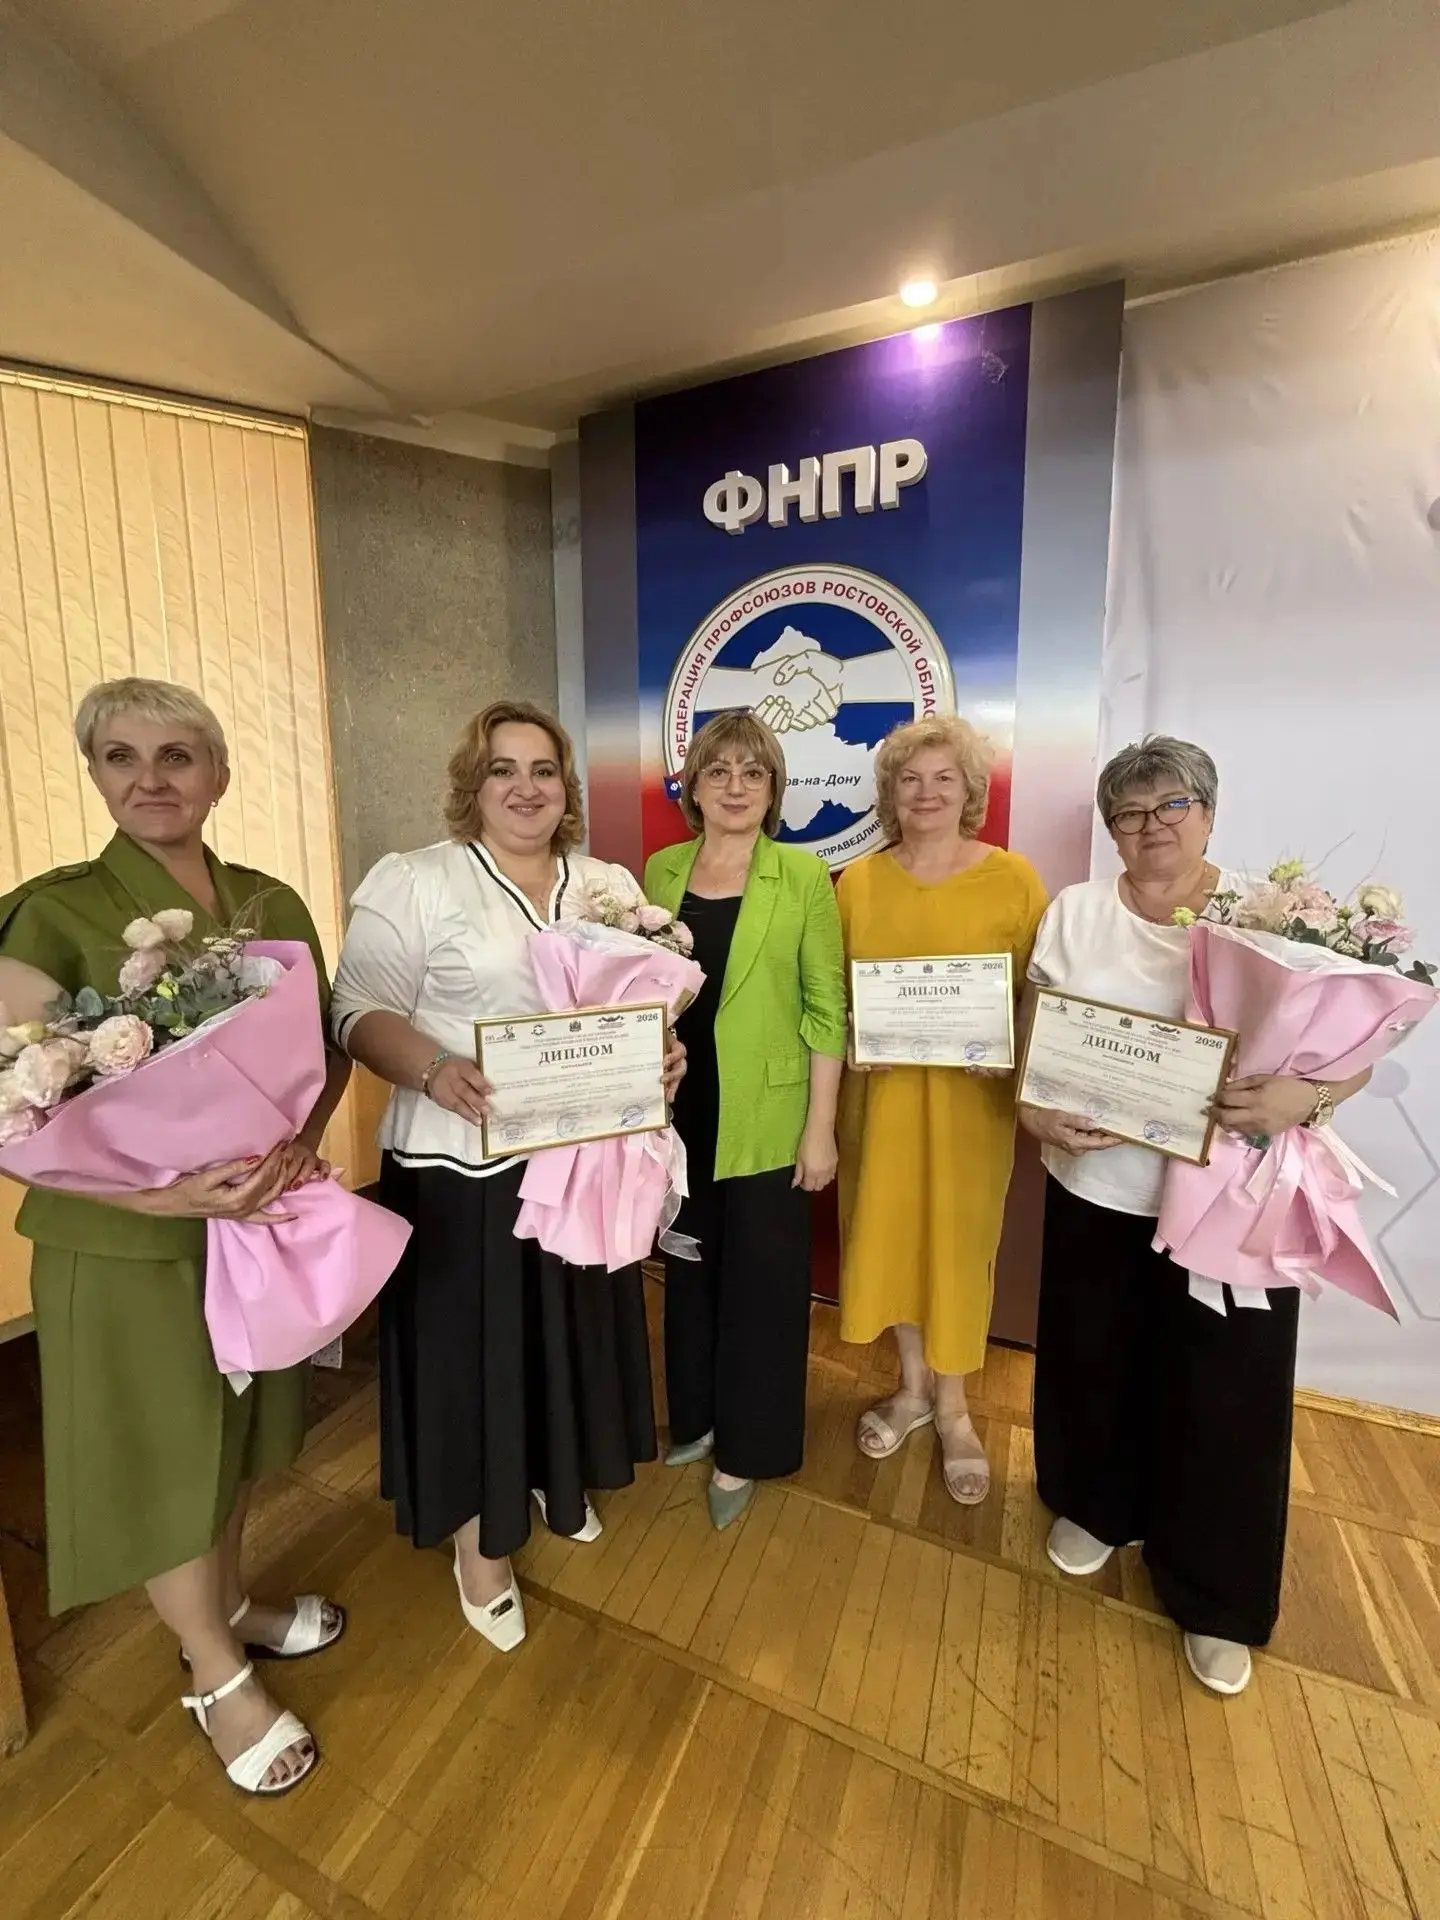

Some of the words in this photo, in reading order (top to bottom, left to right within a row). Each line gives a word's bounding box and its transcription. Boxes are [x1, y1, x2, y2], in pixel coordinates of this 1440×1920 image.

[703, 438, 927, 536] ФНПР
[676, 652, 706, 758] ФЕДЕРАЦИЯ
[704, 581, 816, 652] ПРОФСОЮЗОВ
[822, 581, 924, 655] РОСТОВСКОЙ
[914, 657, 936, 720] ОБЛАС
[785, 774, 861, 787] ов-на-Дону
[816, 818, 882, 858] СПРАВЕДЛИВ
[982, 962, 1004, 970] 2026
[897, 985, 961, 998] ДИПЛОМ
[636, 1013, 659, 1023] 2026
[1081, 1033, 1162, 1064] ДИПЛОМ
[1195, 1035, 1223, 1049] 2026
[538, 1043, 614, 1066] ДИПЛОМ
